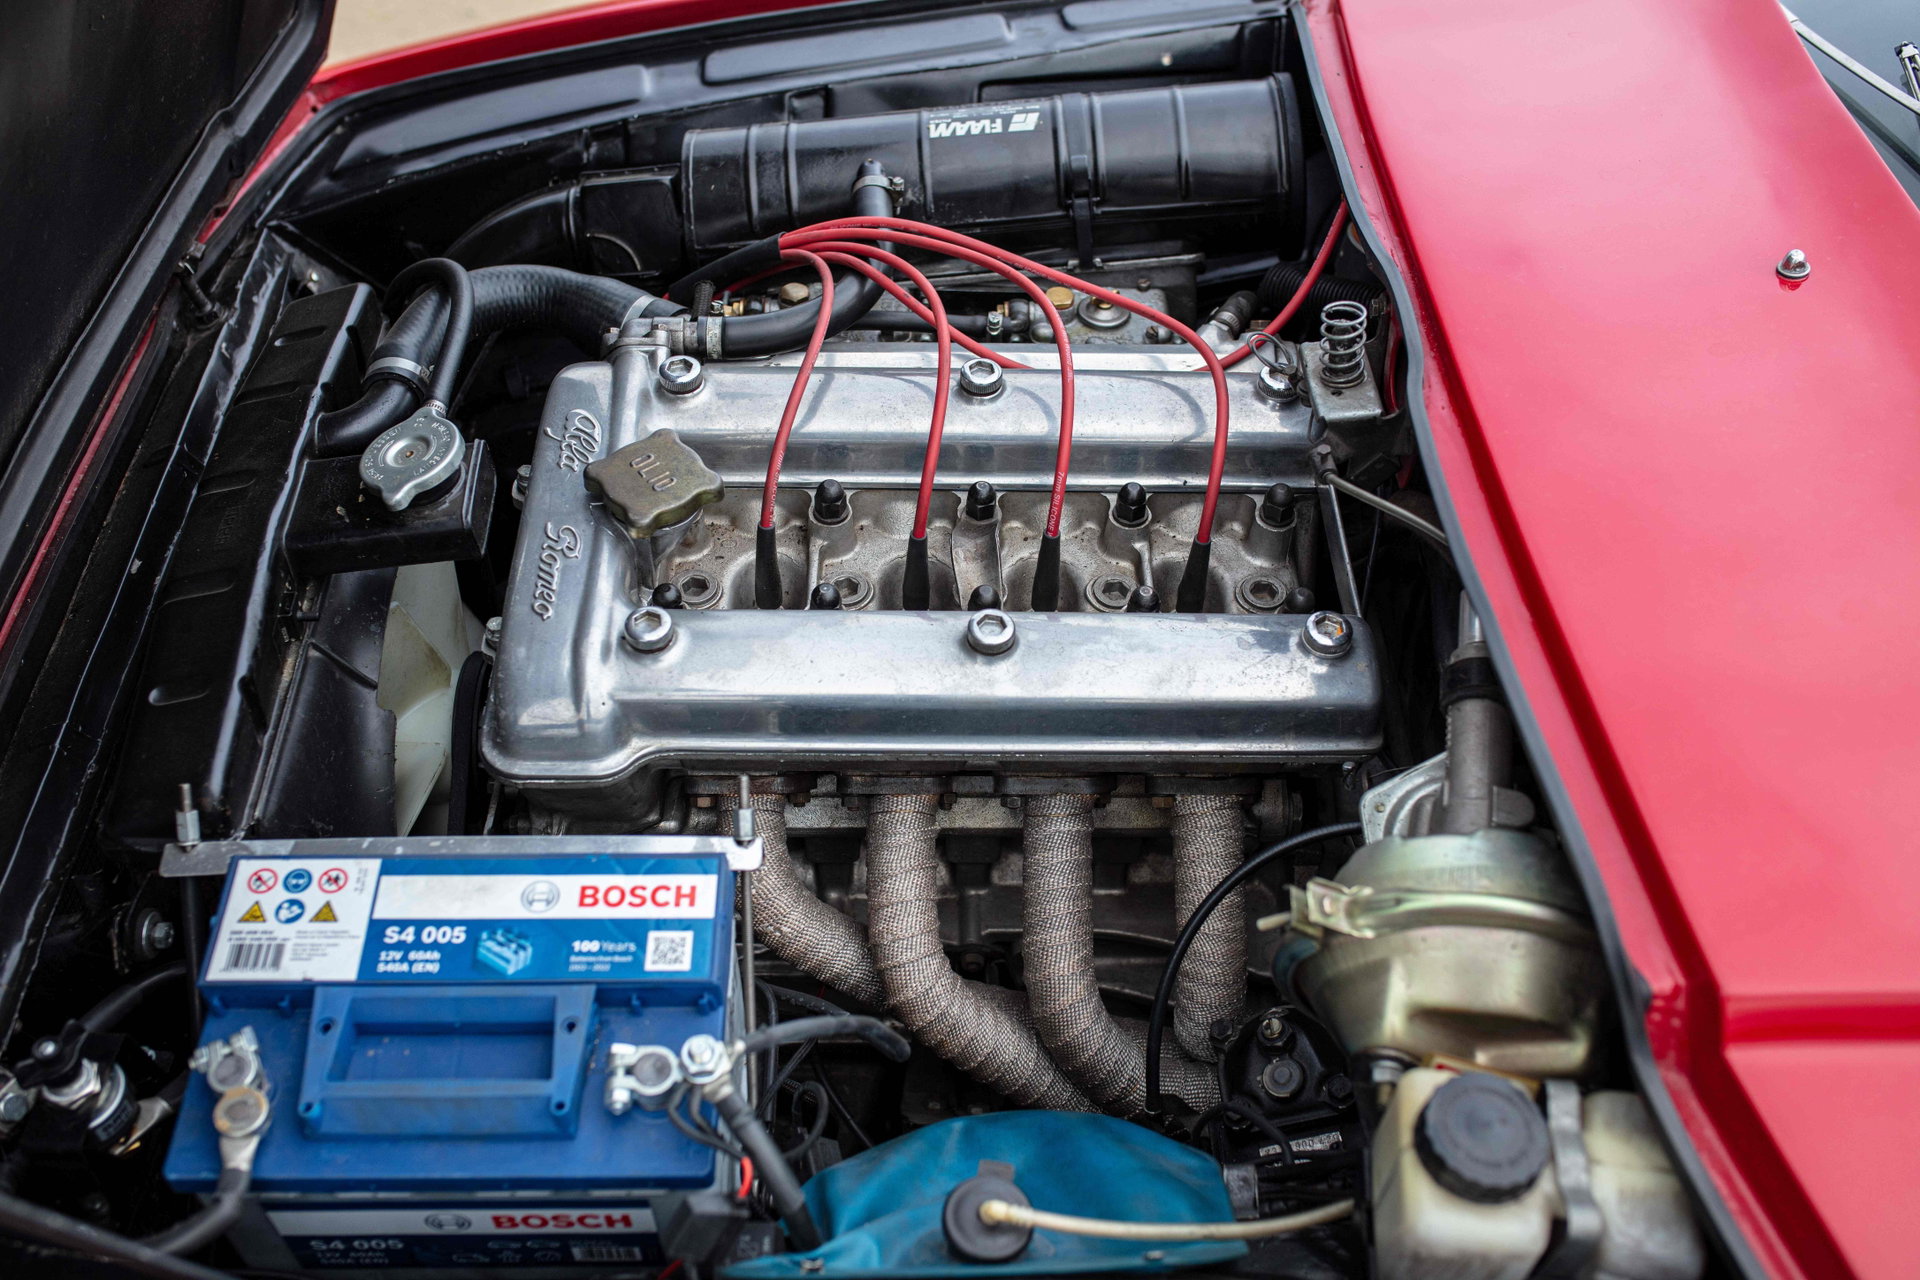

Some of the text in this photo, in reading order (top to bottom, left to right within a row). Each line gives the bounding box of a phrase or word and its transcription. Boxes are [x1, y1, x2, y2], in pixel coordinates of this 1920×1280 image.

[929, 118, 1002, 138] FIAAM
[544, 408, 601, 472] Alfa
[630, 453, 678, 492] OLIO
[1055, 471, 1064, 491] 7mm
[1048, 493, 1060, 531] SILICONE
[532, 522, 583, 621] Romeo
[578, 885, 697, 907] BOSCH
[383, 926, 467, 944] S4 005
[491, 1213, 633, 1229] BOSCH
[310, 1239, 404, 1250] S4 005
